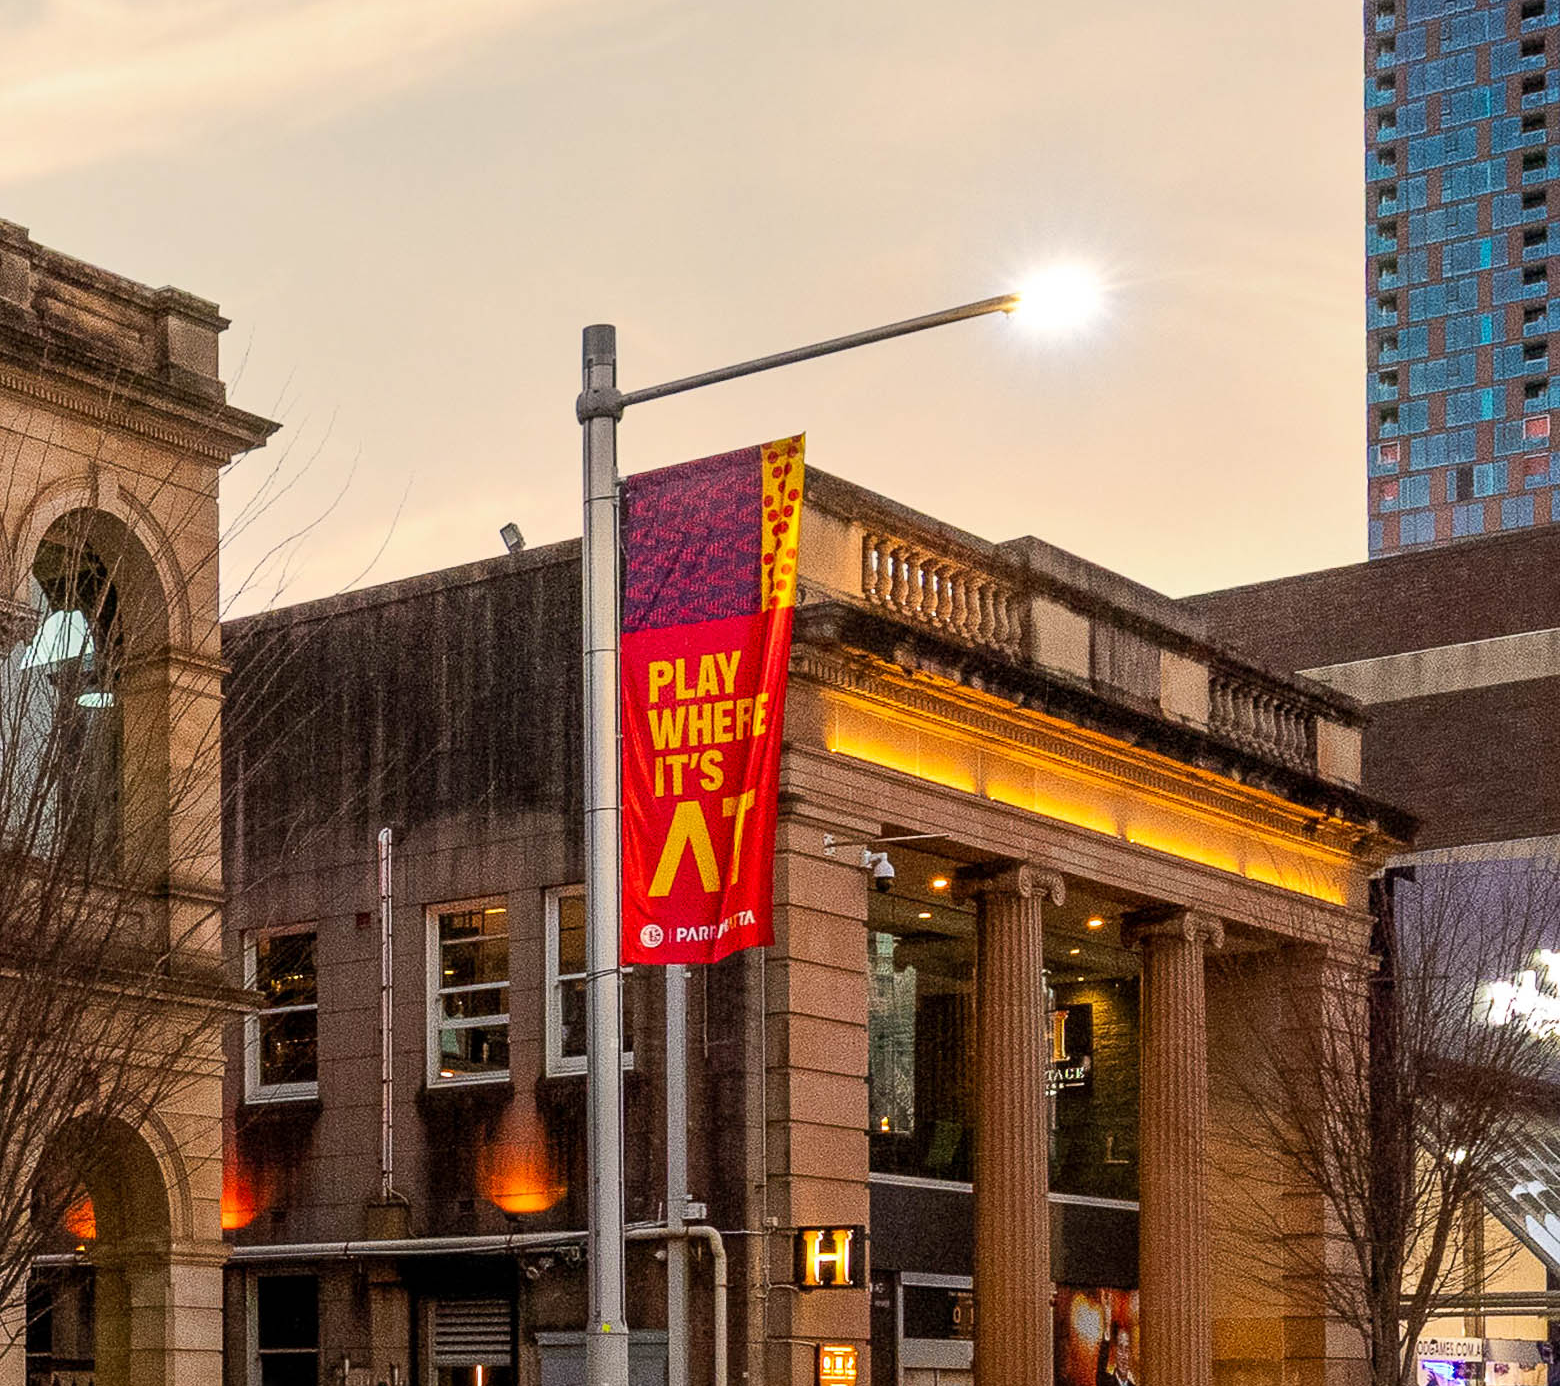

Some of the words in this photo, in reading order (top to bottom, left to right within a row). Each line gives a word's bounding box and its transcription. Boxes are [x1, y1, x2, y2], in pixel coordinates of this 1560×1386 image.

[647, 650, 742, 704] PLAY
[647, 693, 770, 751] WHERE
[653, 748, 725, 798] IT'S
[802, 1229, 855, 1286] H
